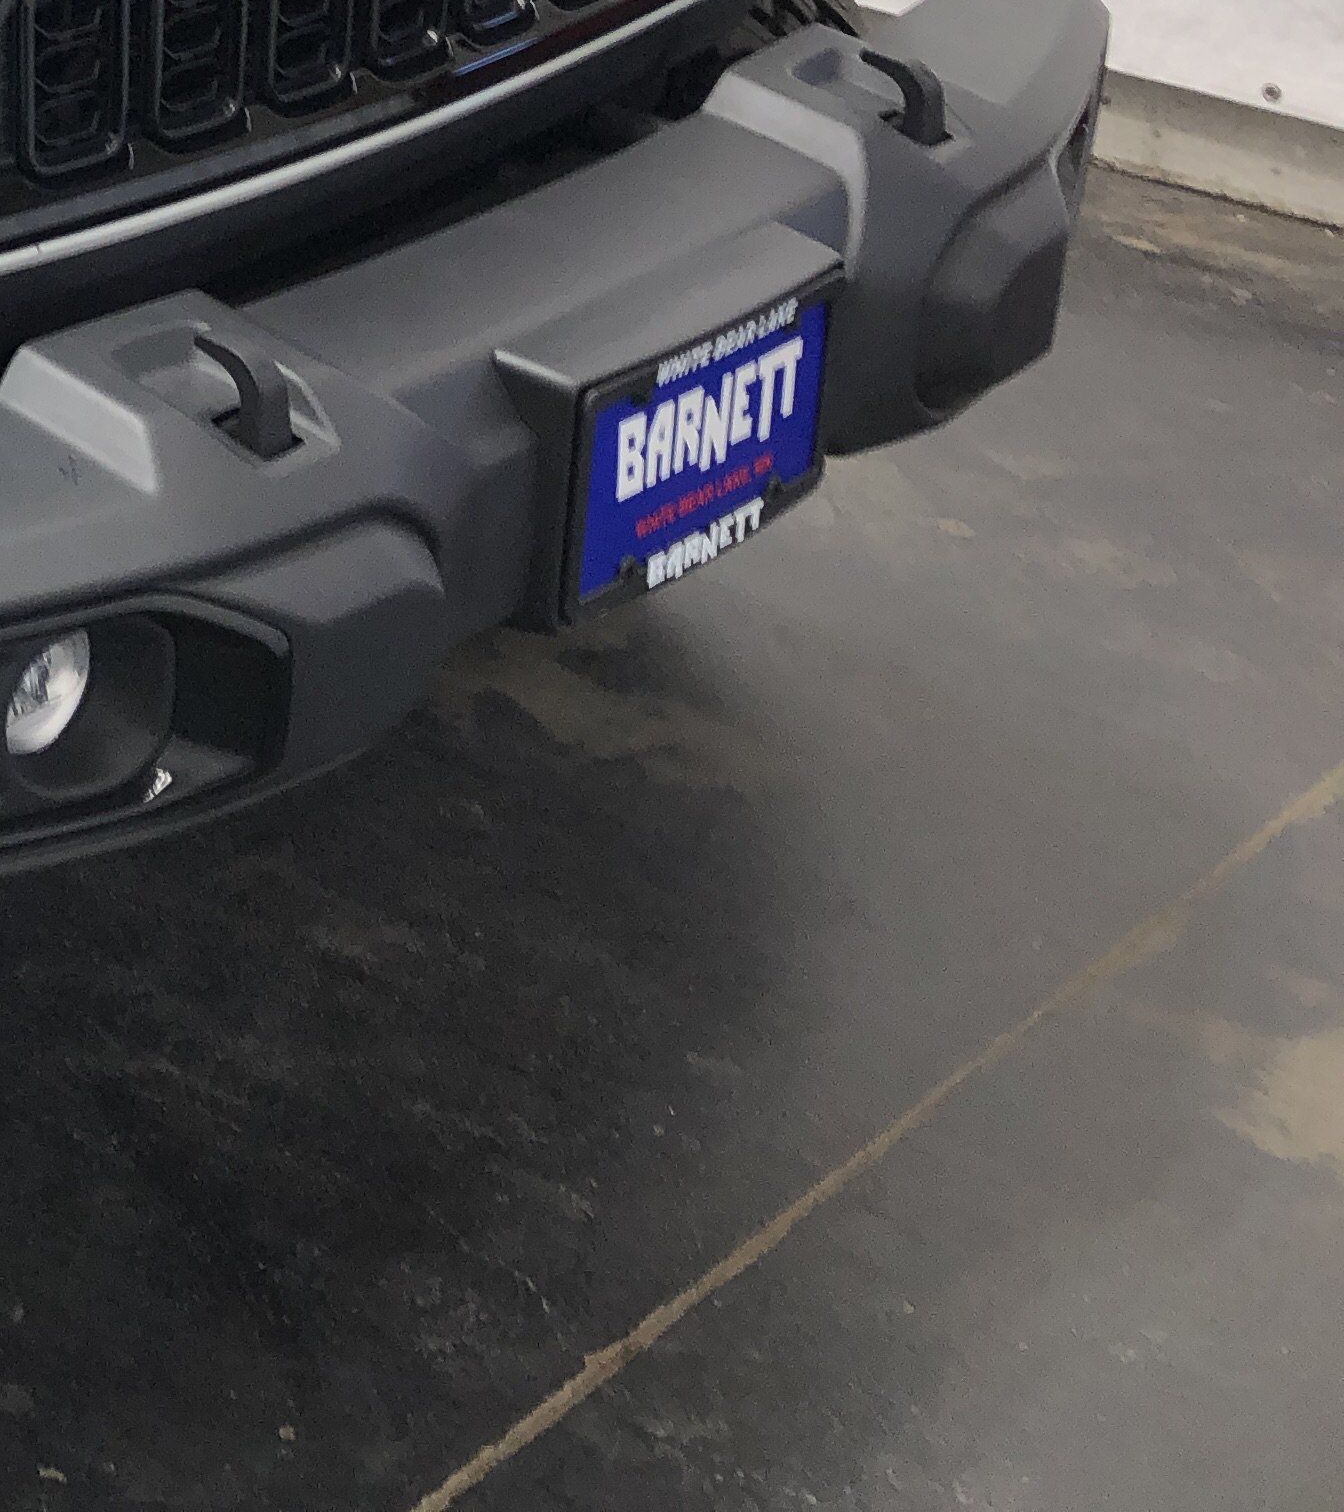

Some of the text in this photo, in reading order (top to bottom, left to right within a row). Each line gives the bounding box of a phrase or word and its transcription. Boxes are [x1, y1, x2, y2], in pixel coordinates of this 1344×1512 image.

[656, 297, 798, 387] WHITE BEAR LAKE
[615, 336, 804, 503] BARNETT
[646, 497, 764, 589] BARNETT
